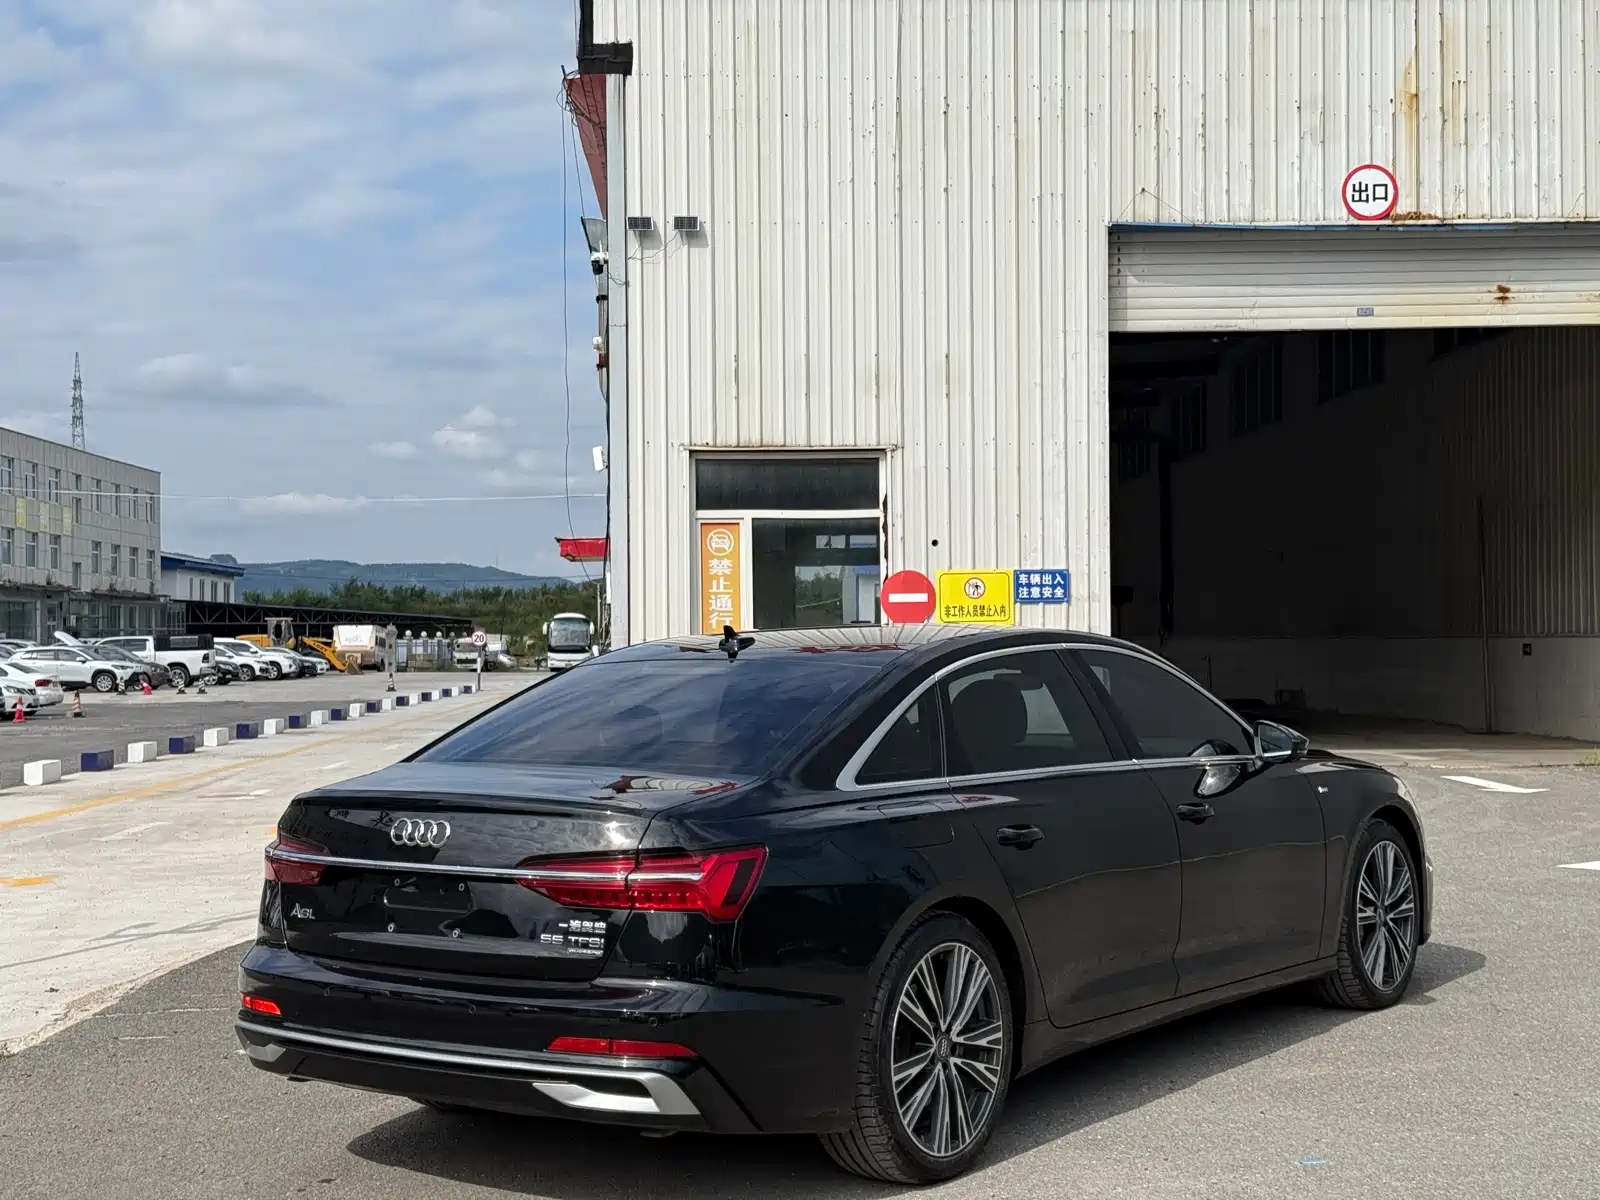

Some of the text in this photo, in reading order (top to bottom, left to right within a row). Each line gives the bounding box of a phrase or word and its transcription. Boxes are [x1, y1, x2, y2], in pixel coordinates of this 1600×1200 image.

[1351, 181, 1388, 203] 出口
[1018, 573, 1065, 585] 车辆出入
[708, 558, 734, 629] 禁止通行
[1018, 586, 1065, 598] 注意安全
[944, 604, 1006, 618] 非工作人员禁止入内
[474, 634, 484, 643] 20
[540, 933, 605, 948] 55 TFSI
